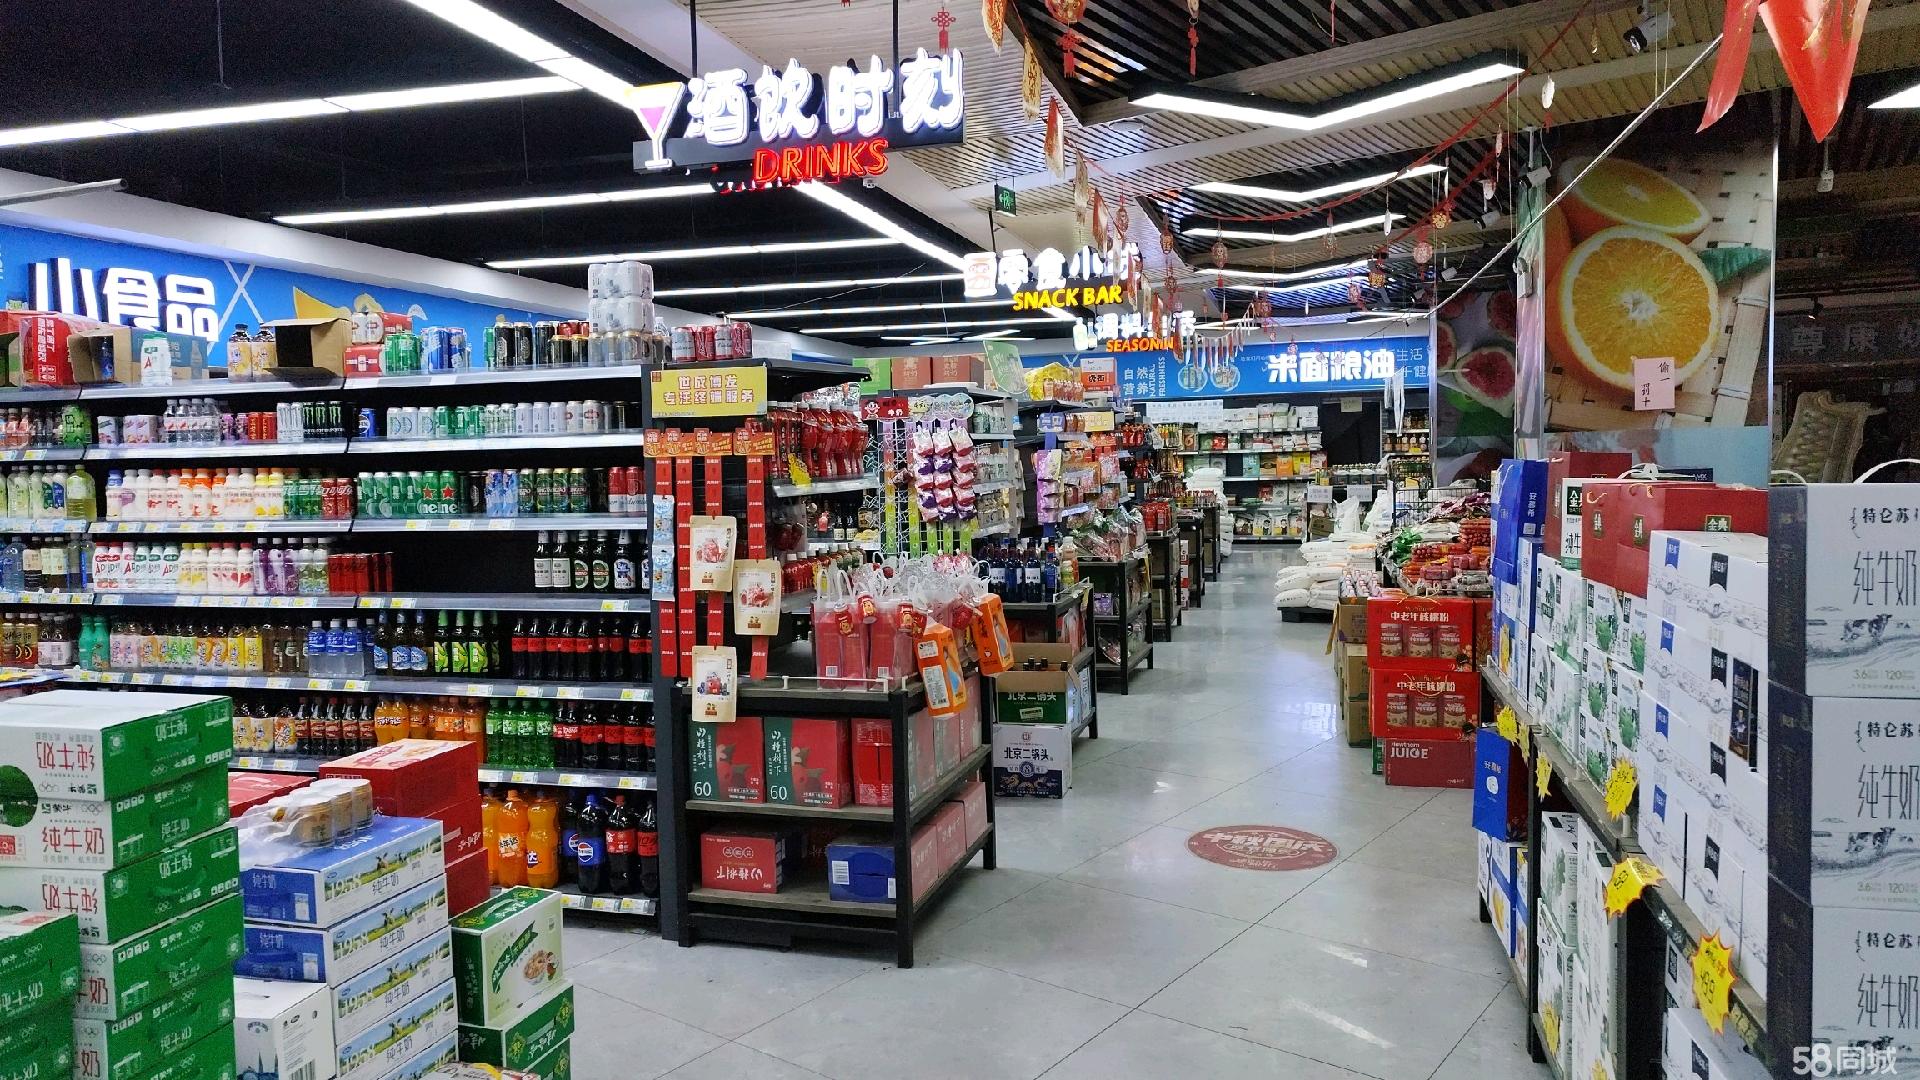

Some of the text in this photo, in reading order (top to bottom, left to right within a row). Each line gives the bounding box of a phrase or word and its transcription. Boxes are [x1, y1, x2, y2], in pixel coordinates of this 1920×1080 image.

[686, 48, 964, 146] 酒饮时刻
[755, 137, 888, 184] DRINKS
[29, 257, 219, 342] 小食品
[1013, 285, 1122, 311] SNACK BAR
[1124, 367, 1149, 380] 自然
[1268, 349, 1395, 383] 米面粮油
[1123, 382, 1149, 396] 营养
[1707, 517, 1729, 531] 金典
[1863, 508, 1909, 523] 特仑苏
[1853, 551, 1917, 606] 纯牛奶
[1867, 722, 1913, 737] 特仑苏
[771, 731, 782, 776] 山楂树下
[1004, 747, 1049, 760] 北京二锅头
[1391, 747, 1428, 759] JUICE
[694, 781, 711, 797] 60
[770, 785, 788, 800] 60
[1858, 764, 1920, 820] 纯牛奶
[42, 827, 105, 855] 纯牛奶
[1867, 932, 1913, 949] 特仑苏
[1857, 973, 1919, 1029] 纯牛奶
